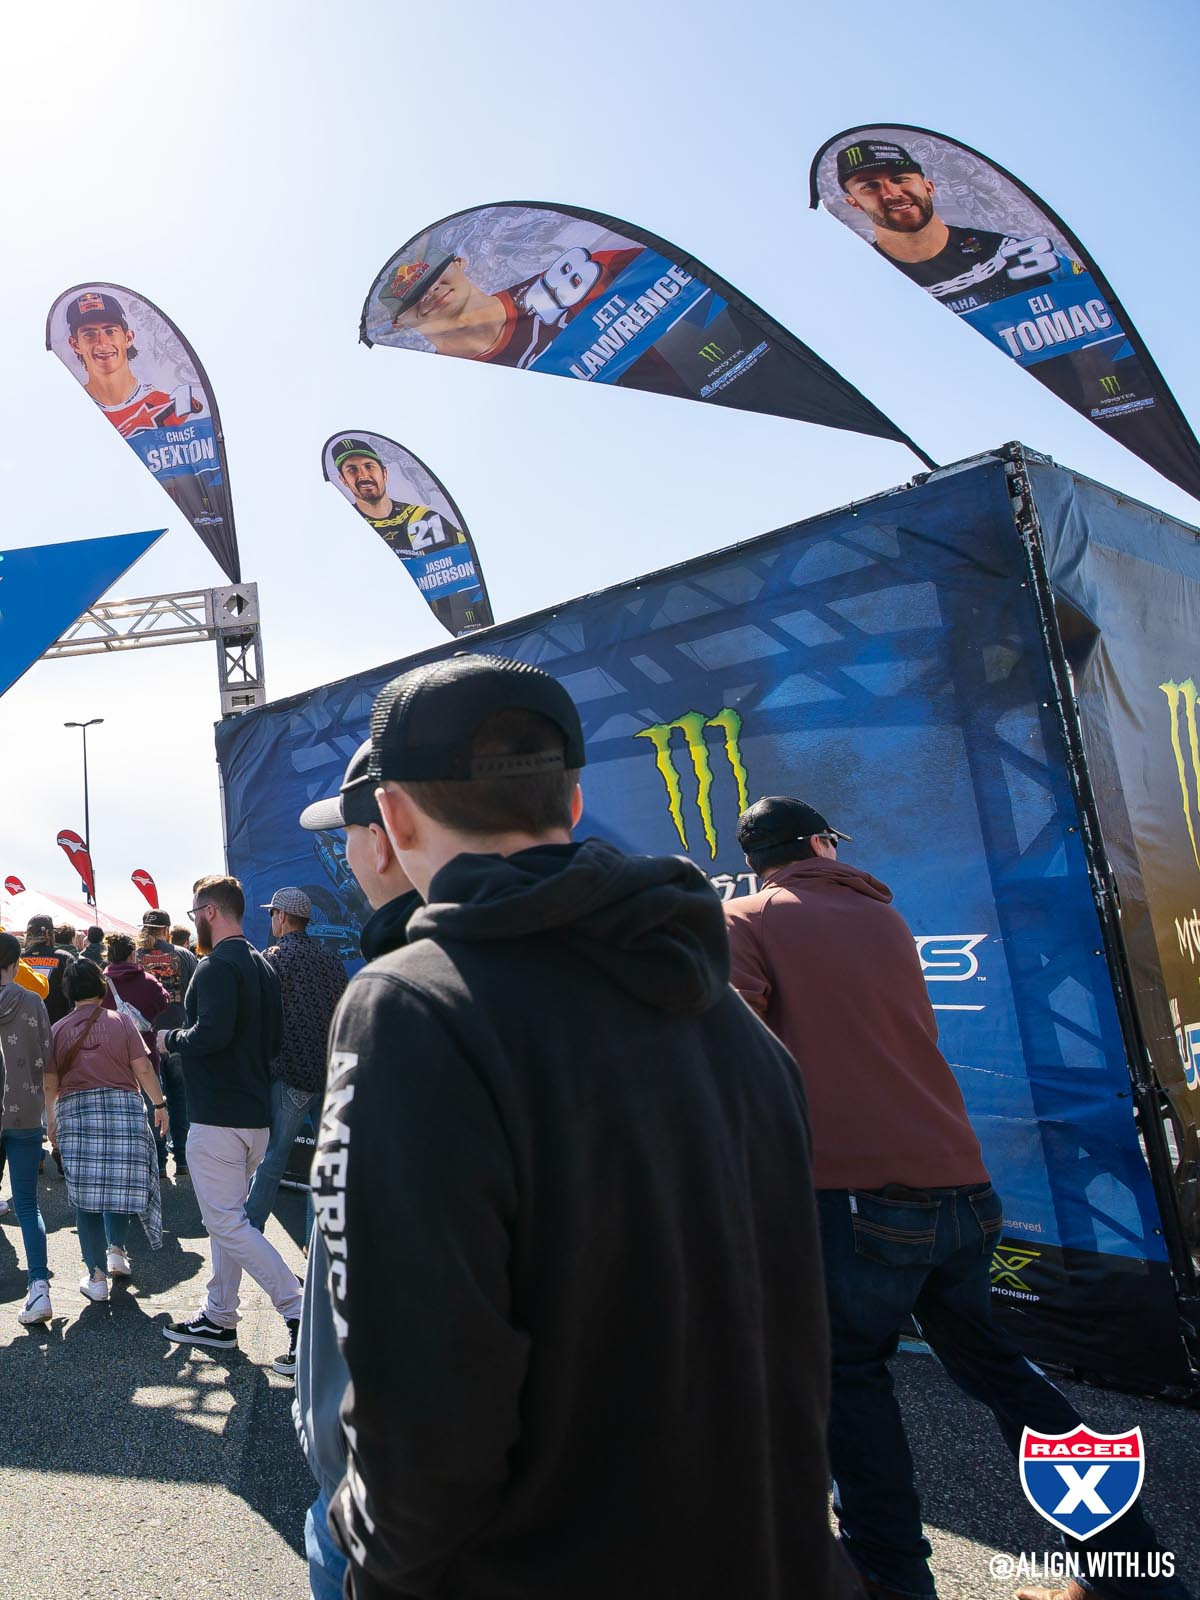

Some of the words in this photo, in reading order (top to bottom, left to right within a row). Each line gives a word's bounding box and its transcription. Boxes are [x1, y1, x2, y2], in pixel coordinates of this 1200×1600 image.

[1001, 236, 1060, 280] 3
[524, 246, 602, 325] 18
[592, 294, 627, 331] JETT
[1028, 294, 1054, 315] ELI
[569, 265, 693, 381] LAWRENCE
[998, 299, 1113, 358] TOMAC
[707, 348, 744, 378] MONSTER
[719, 358, 758, 390] CHAMPIONSHIP
[168, 383, 192, 418] 1
[166, 426, 196, 443] CHASE
[146, 437, 215, 474] SEXTON
[407, 513, 446, 551] 21
[425, 556, 453, 574] JASON
[145, 914, 158, 922] P
[294, 1135, 305, 1144] NG
[1002, 1219, 1046, 1233] eserved.
[990, 1286, 1040, 1302] PIONSHIP
